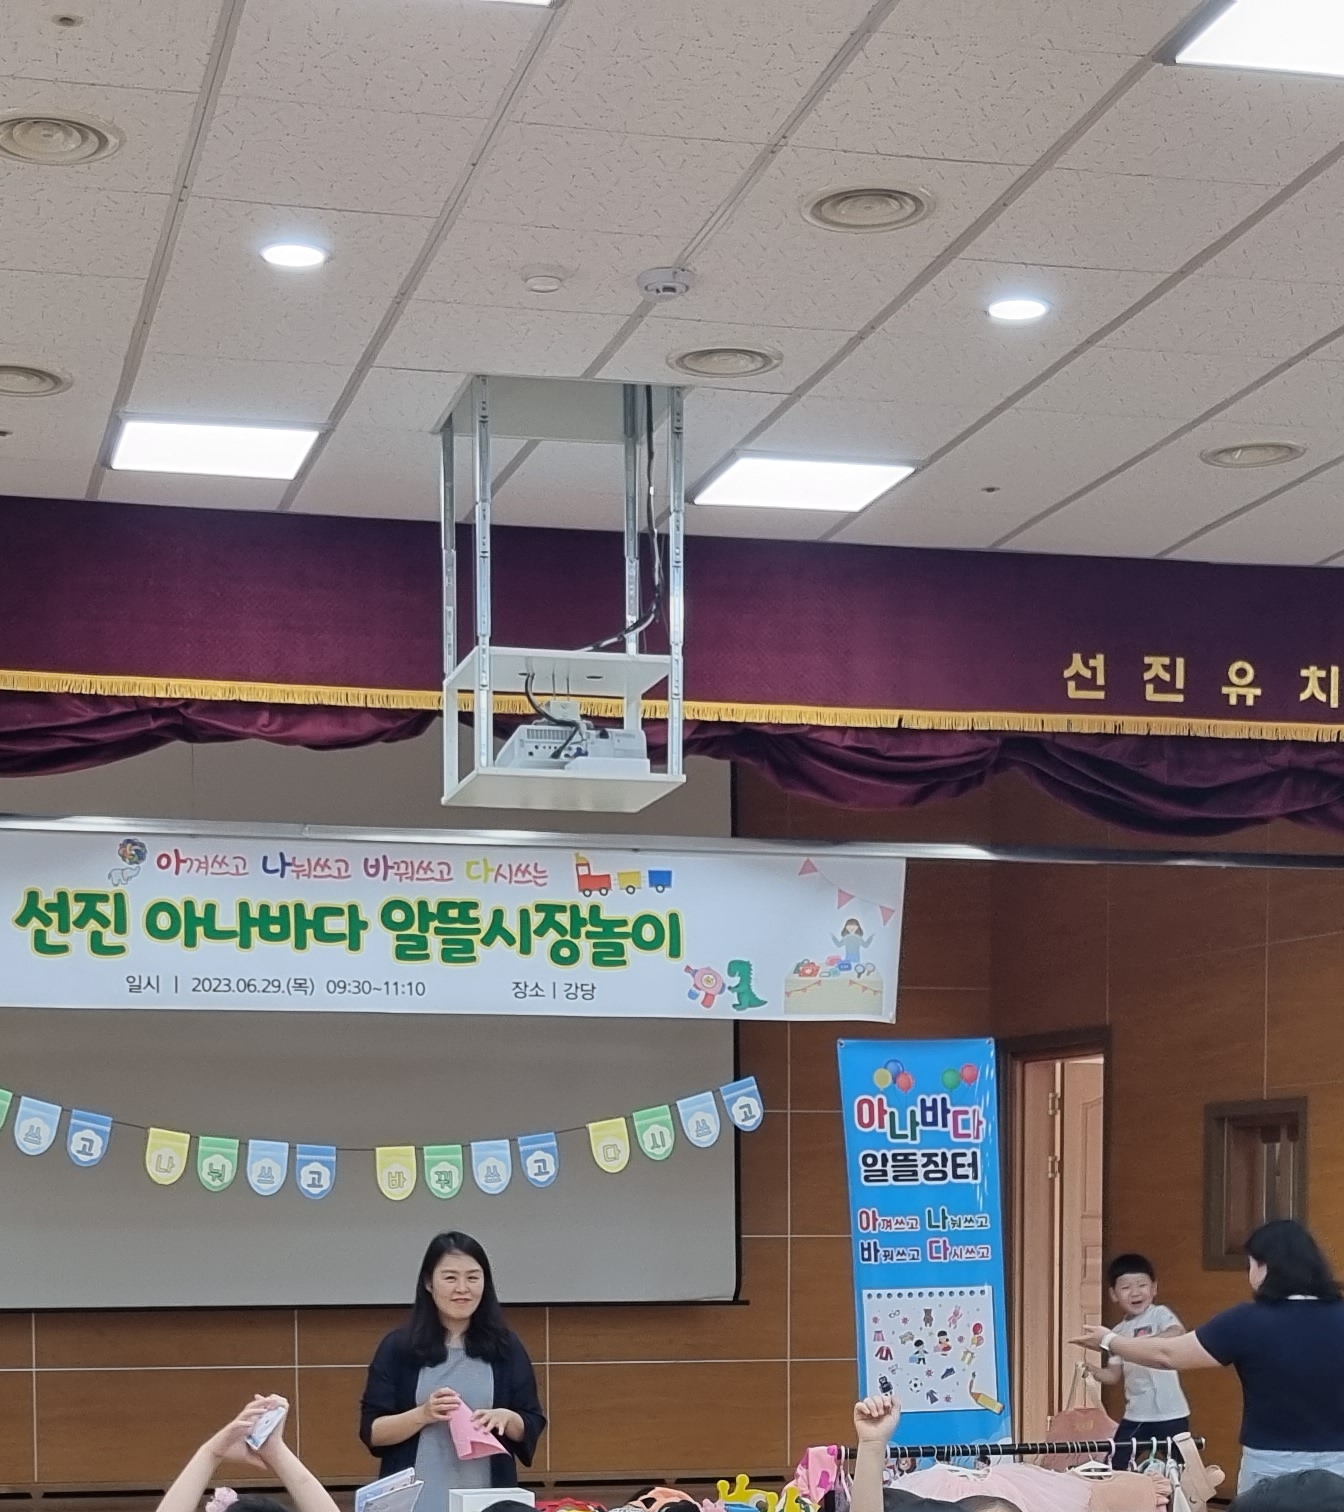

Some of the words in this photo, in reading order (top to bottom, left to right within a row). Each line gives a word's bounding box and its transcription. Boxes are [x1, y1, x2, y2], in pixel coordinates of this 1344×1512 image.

[156, 849, 249, 876] 아껴쓰고
[262, 852, 351, 879] 나눠쓰고
[363, 855, 453, 882] 바꿔쓰고
[466, 857, 548, 886] 다시쓰는
[15, 889, 128, 956] 선진
[145, 899, 369, 952] 아나바다
[380, 898, 681, 966] 알뜰시장놀이
[126, 975, 160, 993] 일시
[191, 976, 315, 995] 2023.06.29.(목)
[325, 979, 426, 996] 09:30~11:10
[511, 981, 546, 999] 장소
[563, 982, 596, 1001] 강당
[856, 1096, 984, 1141] 아나바다
[861, 1151, 978, 1183] 알뜰장터
[859, 1209, 919, 1231] 아껴쓰고
[927, 1208, 988, 1229] 나눠쓰고
[928, 1239, 990, 1260] 다시쓰고
